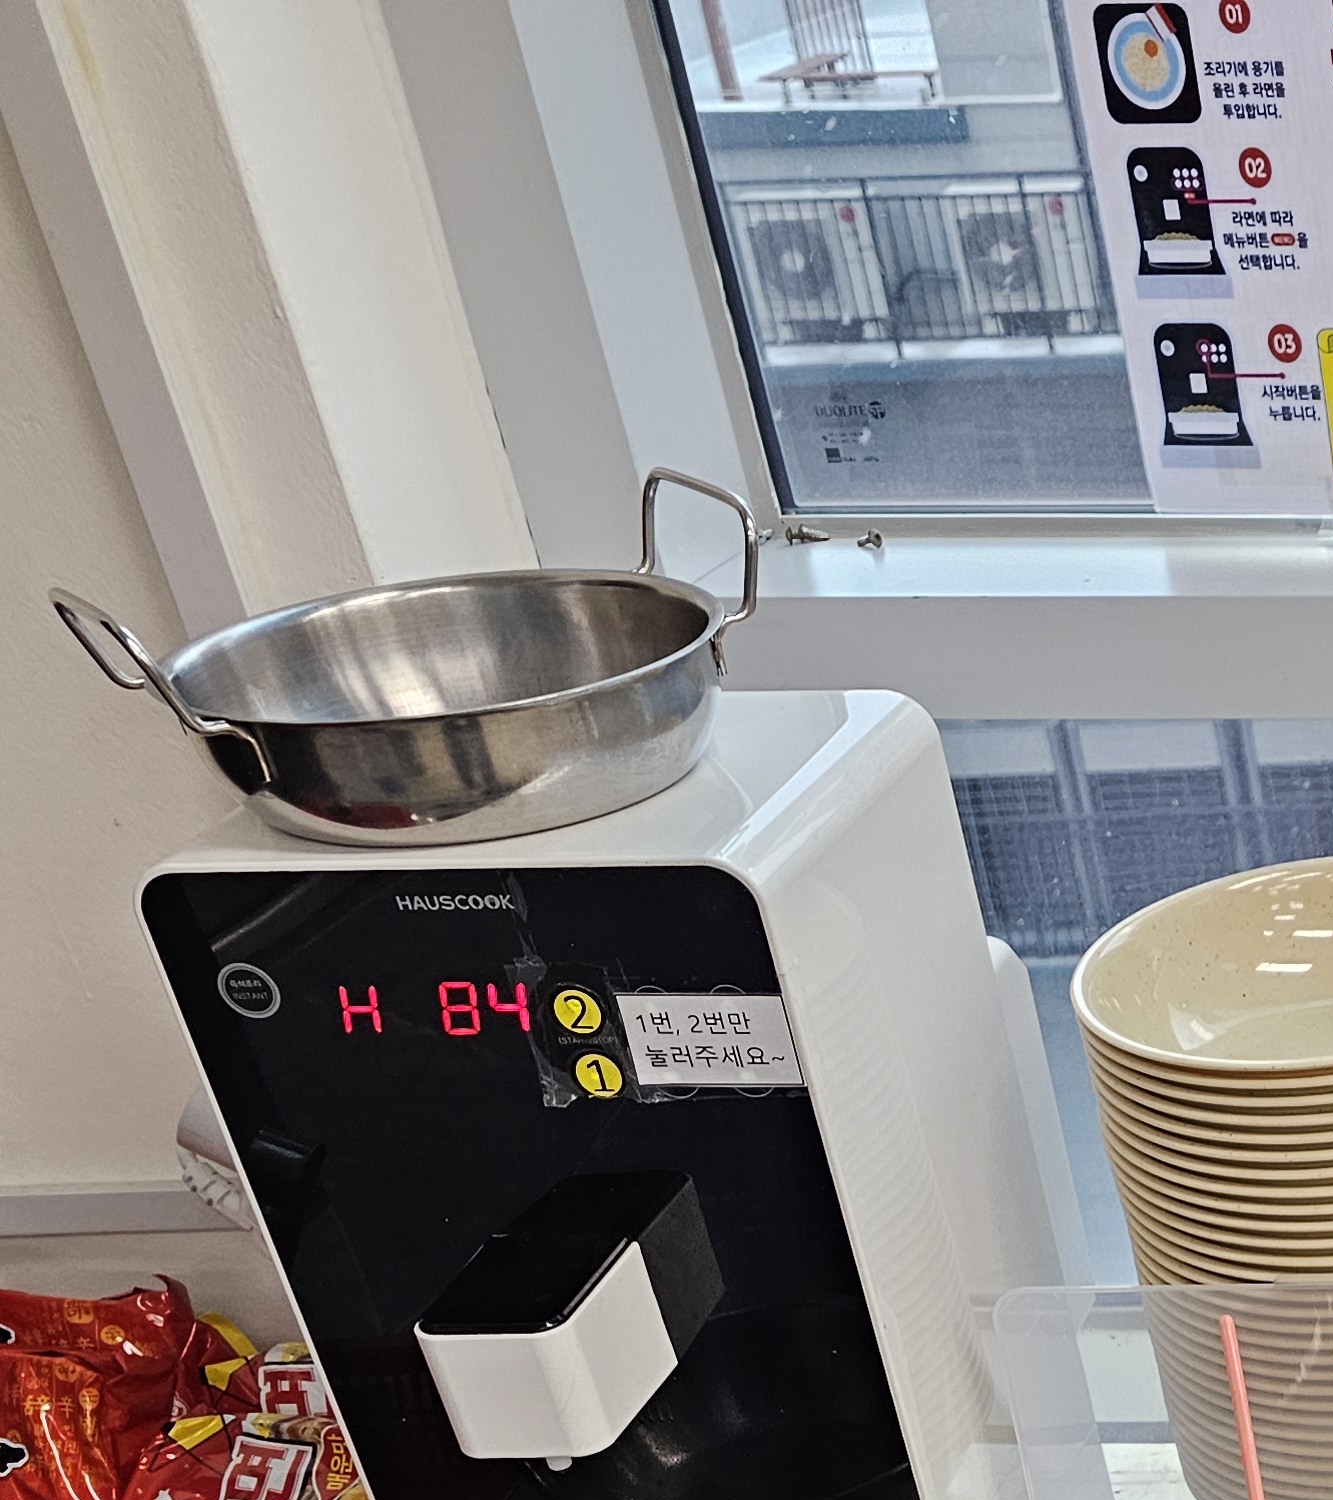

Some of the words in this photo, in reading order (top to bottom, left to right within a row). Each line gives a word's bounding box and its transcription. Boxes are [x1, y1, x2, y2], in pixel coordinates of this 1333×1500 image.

[1225, 4, 1242, 24] 01
[1204, 60, 1249, 77] 조리기에
[1252, 60, 1284, 77] 용기를
[1213, 82, 1235, 98] 올린
[1239, 82, 1250, 98] 후
[1252, 82, 1285, 98] 라면을
[1223, 103, 1282, 119] 투입합니다.
[1244, 157, 1267, 178] 02
[1232, 210, 1267, 227] 라면에
[1270, 210, 1294, 227] 따라
[1223, 232, 1270, 249] 메뉴버튼
[1239, 254, 1300, 271] 선택합니다.
[1273, 333, 1296, 354] 03
[1262, 384, 1321, 401] 시작버튼을
[1269, 405, 1321, 421] 누릅니다.
[395, 893, 516, 911] HAUSCOOK
[338, 985, 382, 1033] H
[438, 981, 531, 1036] 84
[563, 995, 595, 1029] 2
[636, 1012, 680, 1036] 1번,
[688, 1011, 751, 1035] 2번만
[645, 1045, 785, 1068] 눌러주세요~
[586, 1059, 616, 1093] 1
